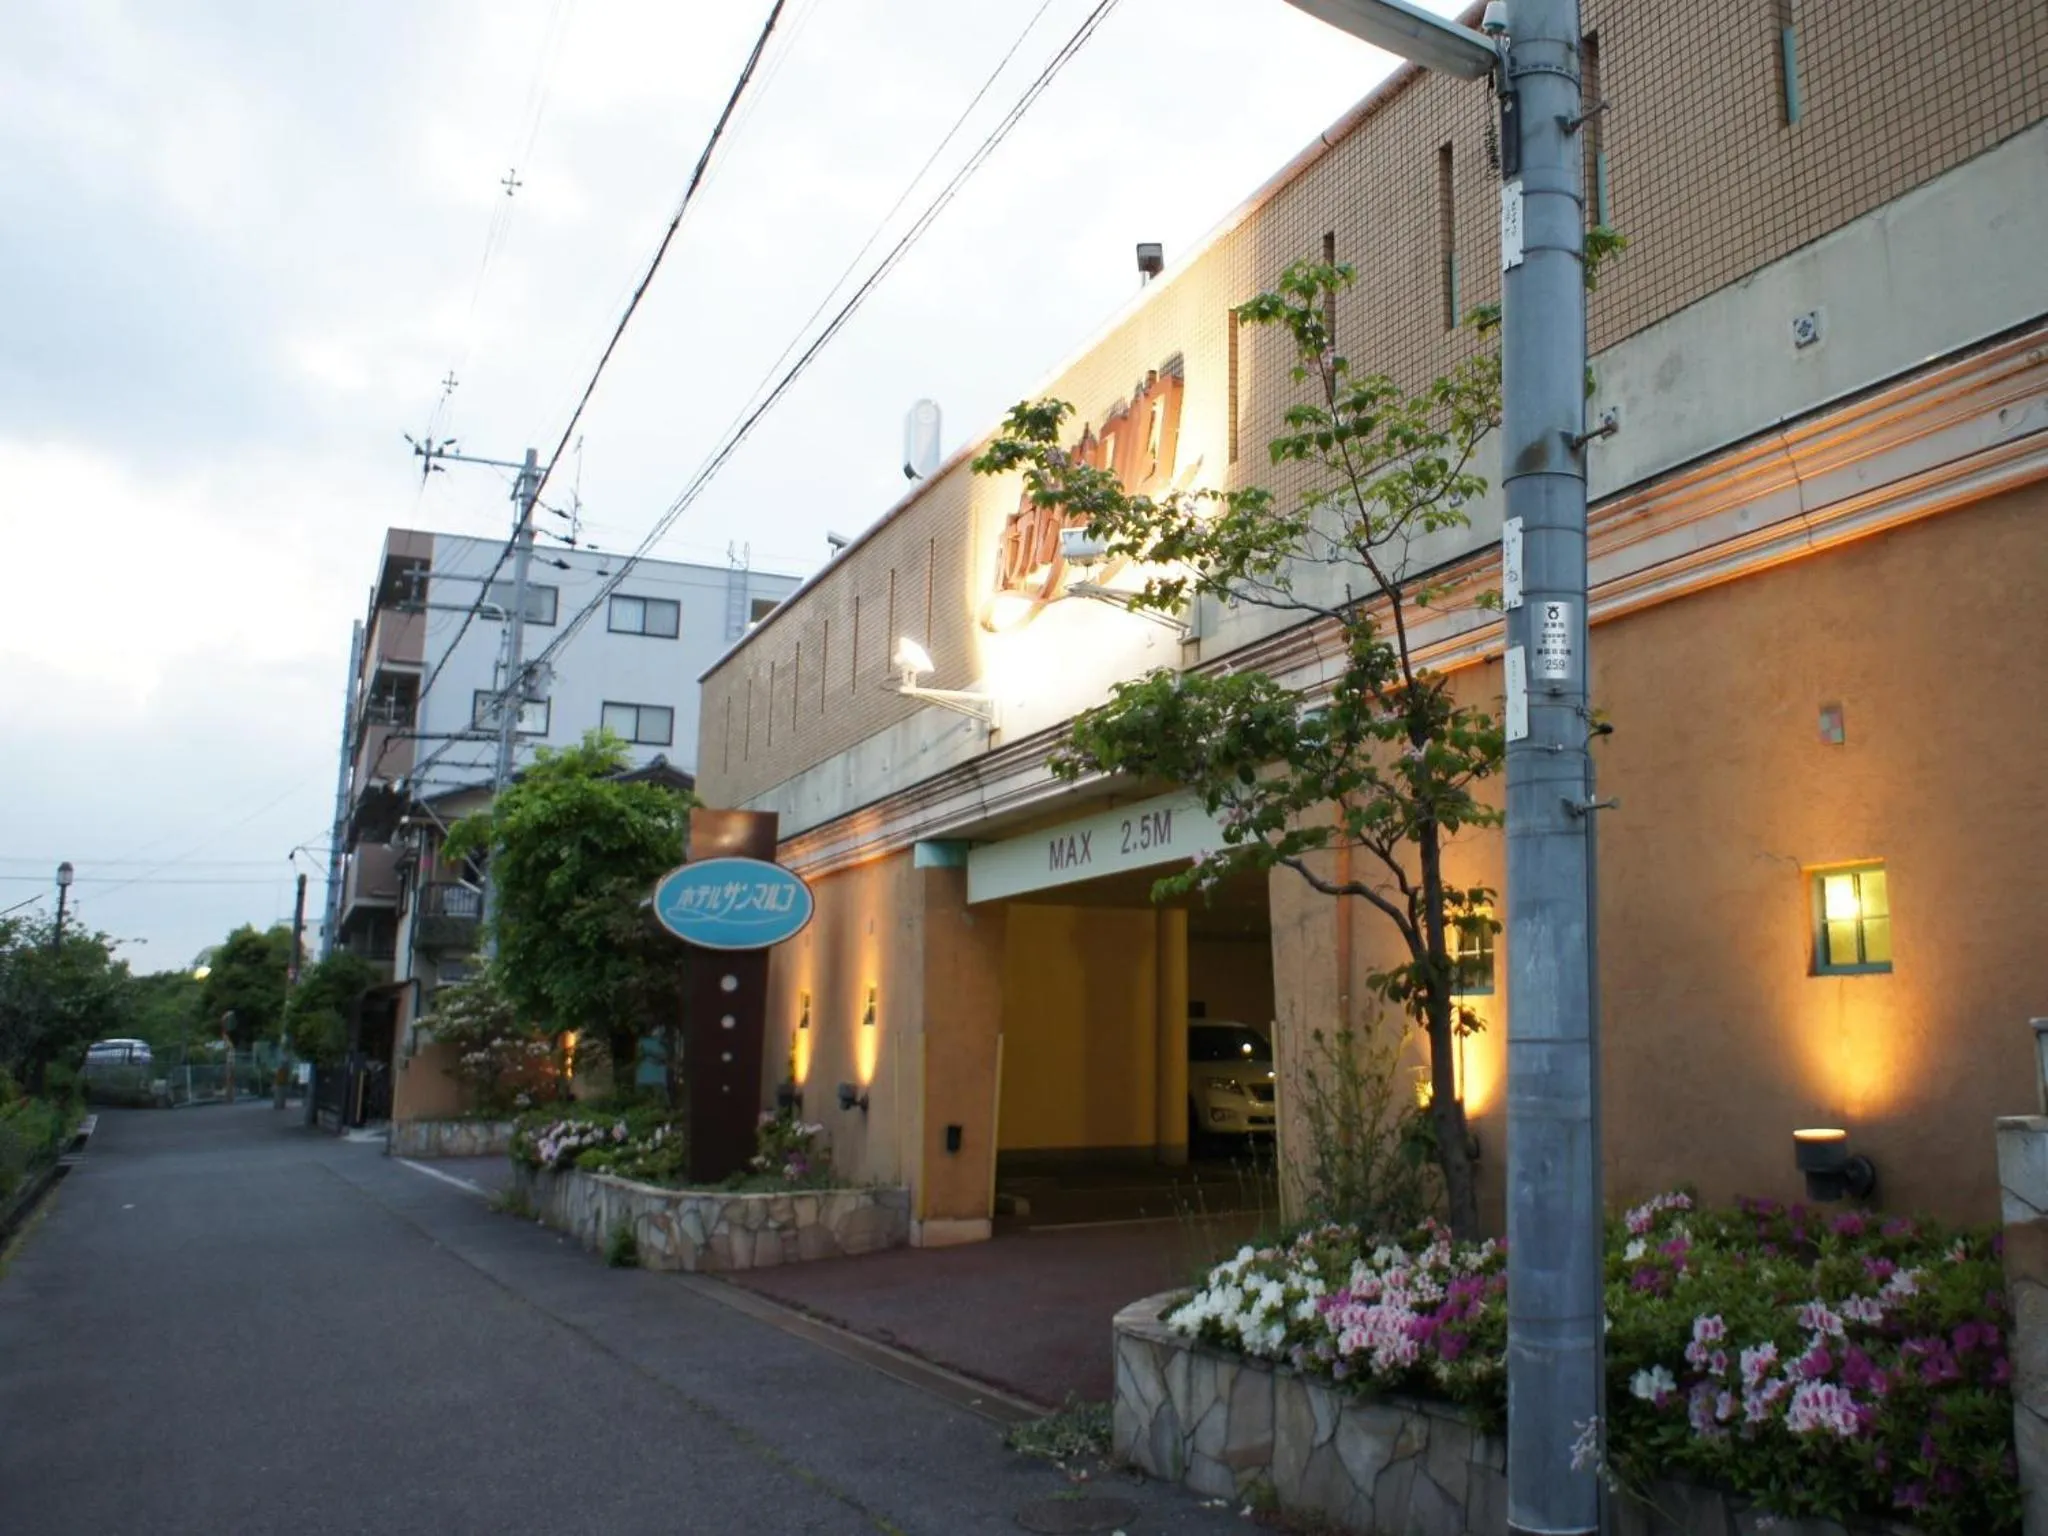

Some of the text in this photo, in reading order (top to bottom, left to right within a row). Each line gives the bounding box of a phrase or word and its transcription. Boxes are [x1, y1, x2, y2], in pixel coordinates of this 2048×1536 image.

[1544, 658, 1566, 671] 259
[1049, 808, 1172, 872] MAX 2.5M
